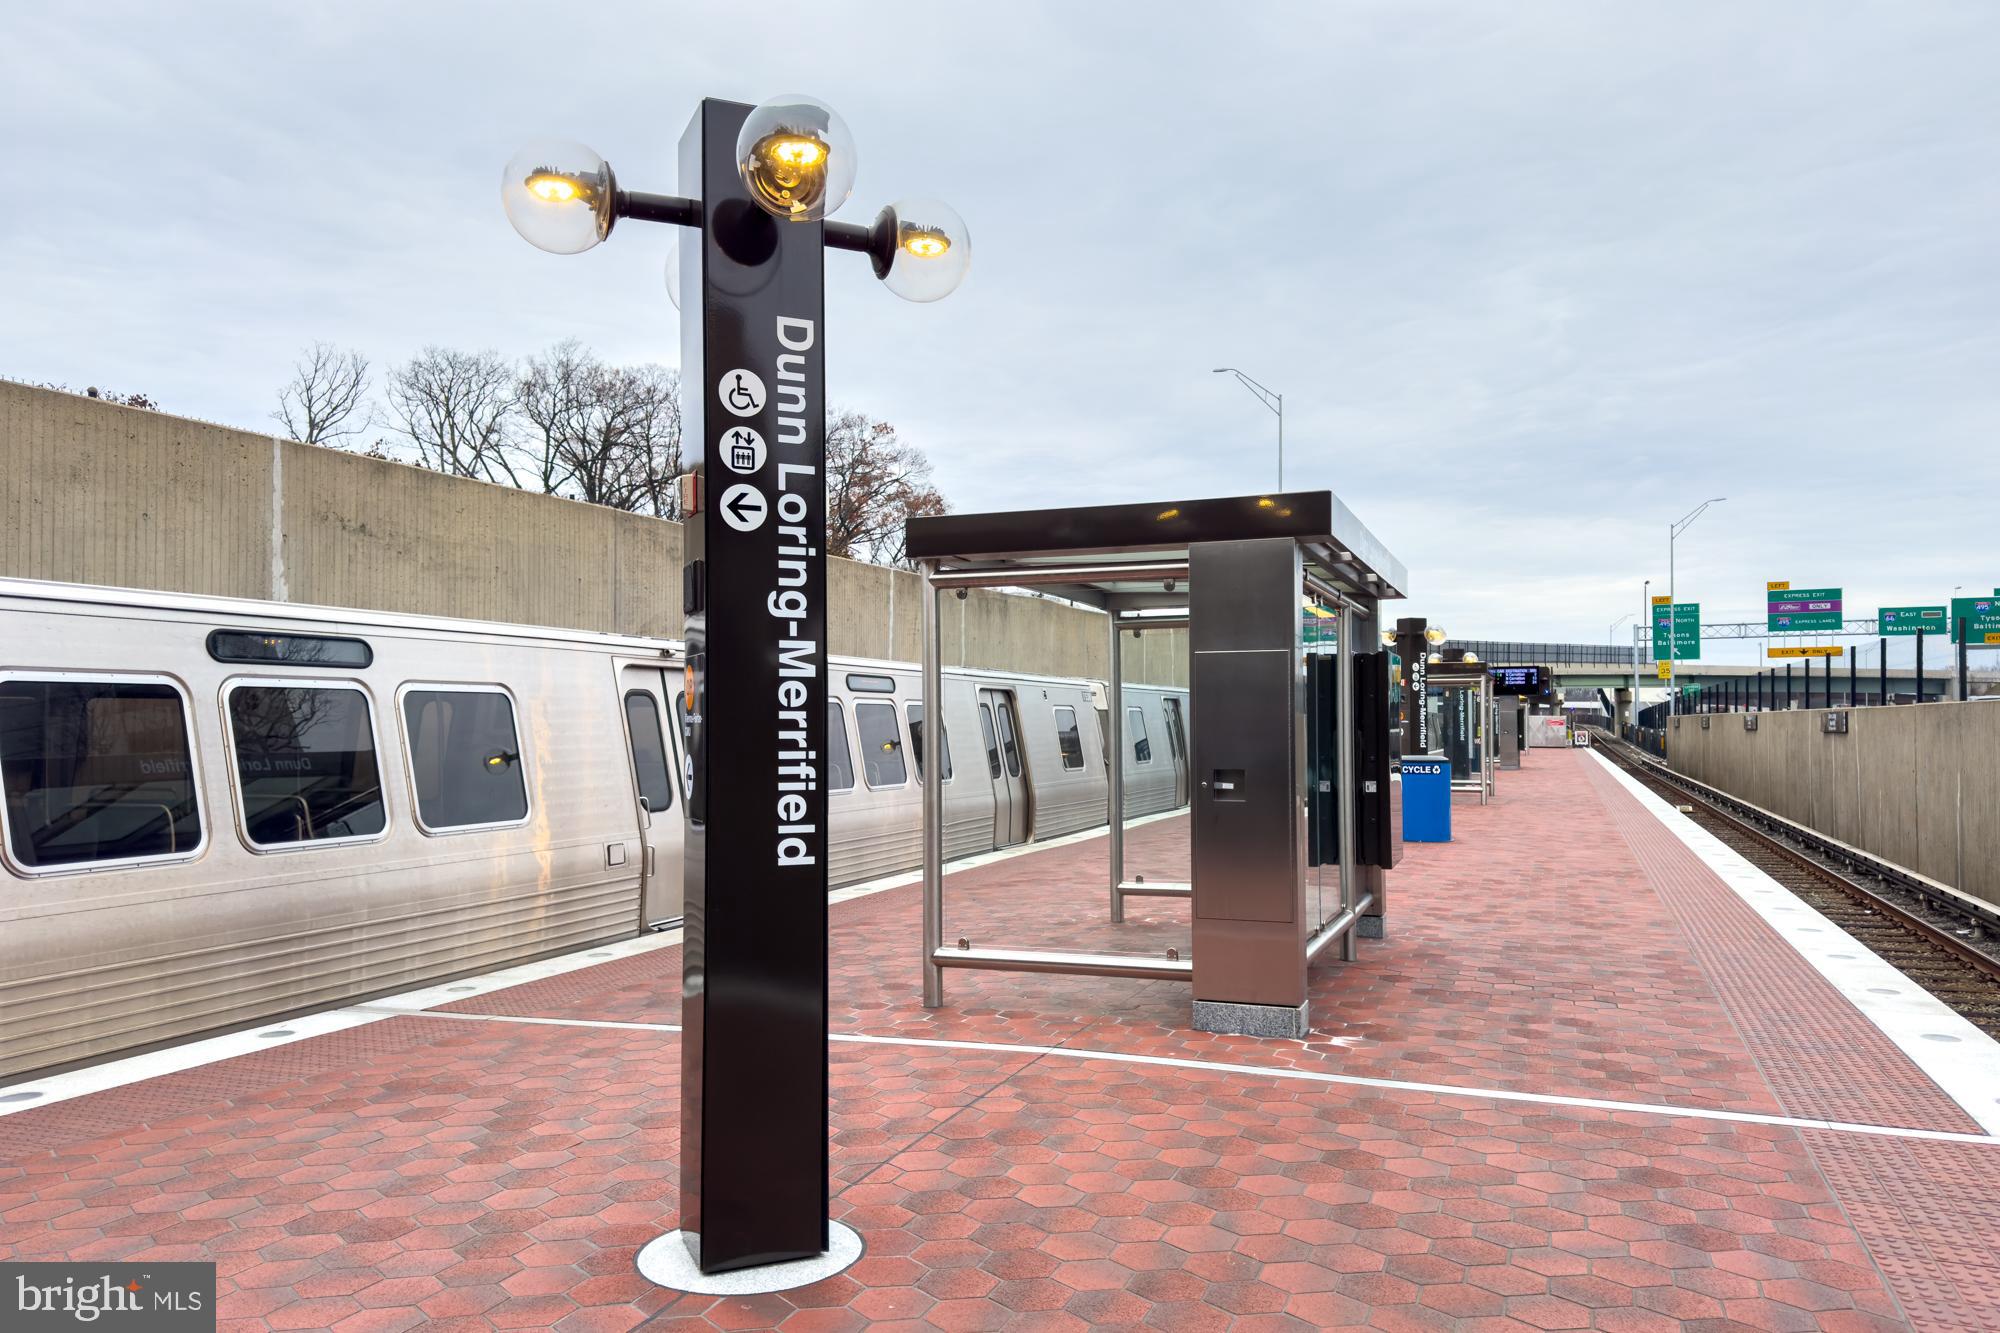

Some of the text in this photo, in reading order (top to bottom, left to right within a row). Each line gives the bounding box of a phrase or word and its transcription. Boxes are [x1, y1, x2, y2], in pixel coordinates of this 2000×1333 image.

[767, 316, 817, 866] Dunn Loring-Merrifield
[1418, 677, 1427, 748] Loring-Merrifield
[1402, 765, 1432, 774] CYCLE
